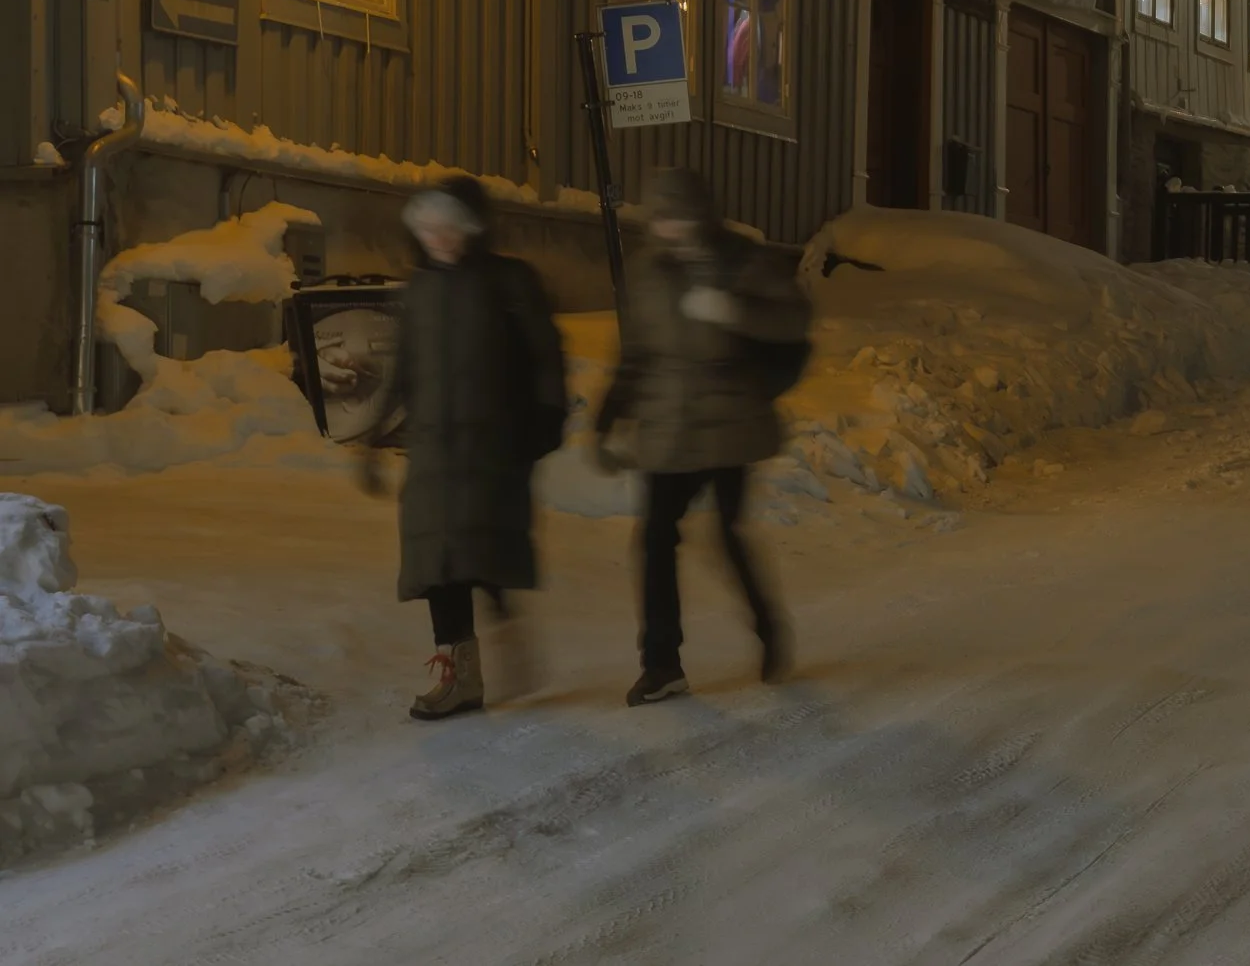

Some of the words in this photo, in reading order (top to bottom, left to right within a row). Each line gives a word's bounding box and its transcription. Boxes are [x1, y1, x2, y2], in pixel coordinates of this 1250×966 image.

[621, 15, 660, 74] P
[615, 90, 643, 102] 09-18
[619, 104, 642, 113] Maks
[627, 114, 644, 123] mot
[649, 110, 674, 121] avgift
